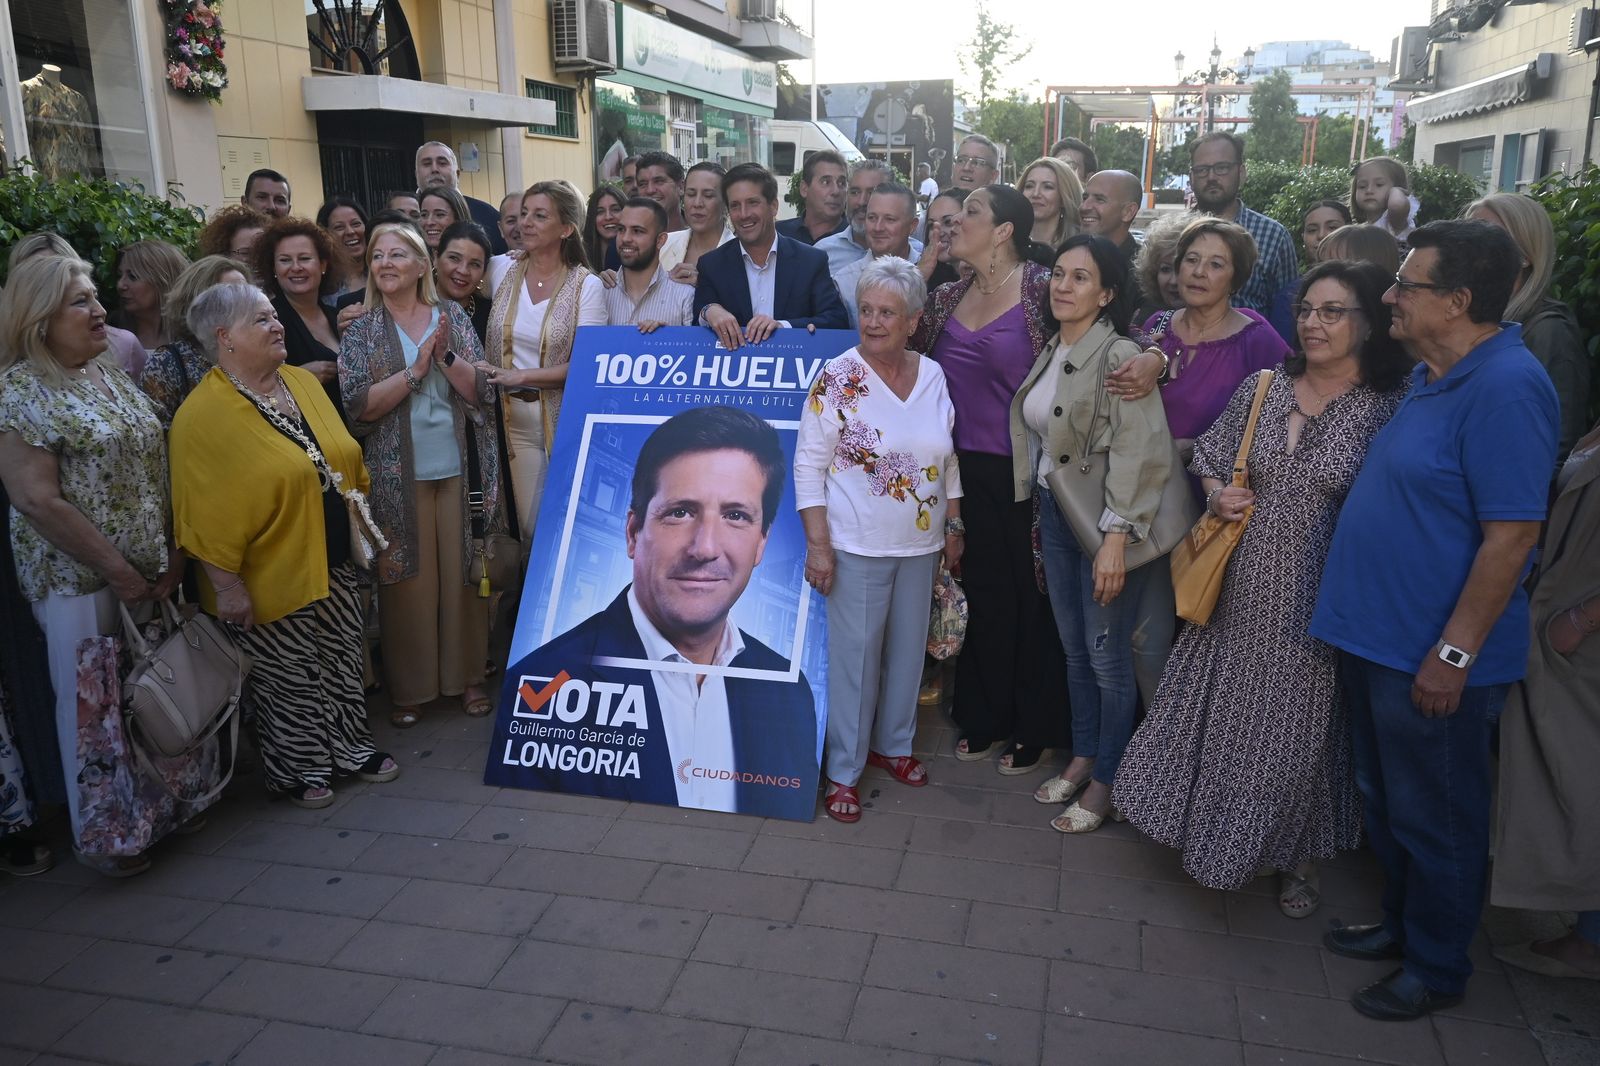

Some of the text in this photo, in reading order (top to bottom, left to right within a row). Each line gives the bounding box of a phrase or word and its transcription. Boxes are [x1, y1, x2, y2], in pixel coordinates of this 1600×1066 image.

[652, 114, 665, 130] Casa
[595, 353, 831, 390] 100% HUELV
[633, 392, 795, 407] LA ALTERNATIVA ÚTIL
[509, 720, 646, 747] Guillermo García de
[502, 739, 641, 779] LONGORIA
[692, 767, 801, 789] CIUDADANOS
